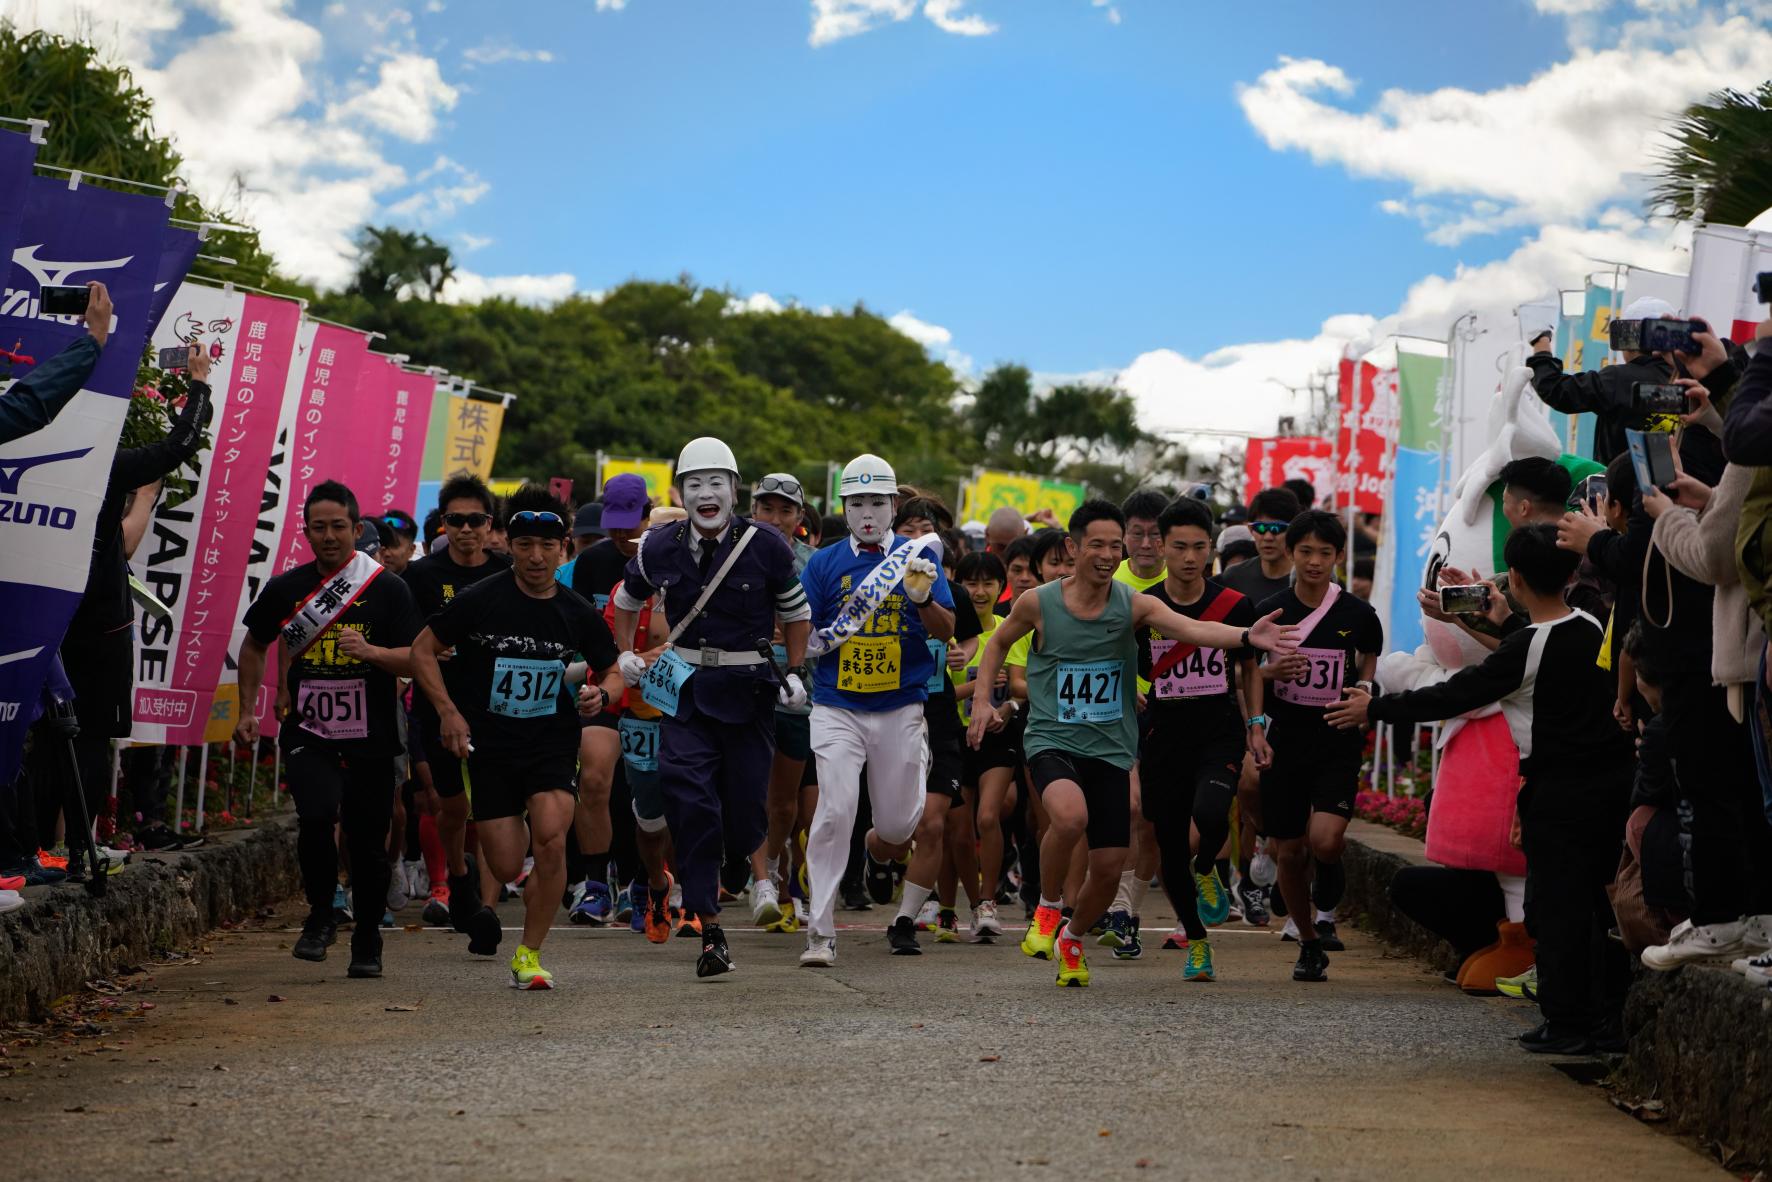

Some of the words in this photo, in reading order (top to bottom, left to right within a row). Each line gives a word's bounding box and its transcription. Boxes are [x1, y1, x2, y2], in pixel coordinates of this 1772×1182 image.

[381, 390, 410, 513] 鹿児島のインタ
[139, 462, 203, 684] NAPSE
[842, 659, 897, 675] まもるくん
[852, 647, 887, 661] えらぶ
[496, 670, 558, 702] 4312
[1059, 669, 1121, 705] 4427
[1283, 658, 1340, 690] 031
[302, 690, 362, 722] 6051
